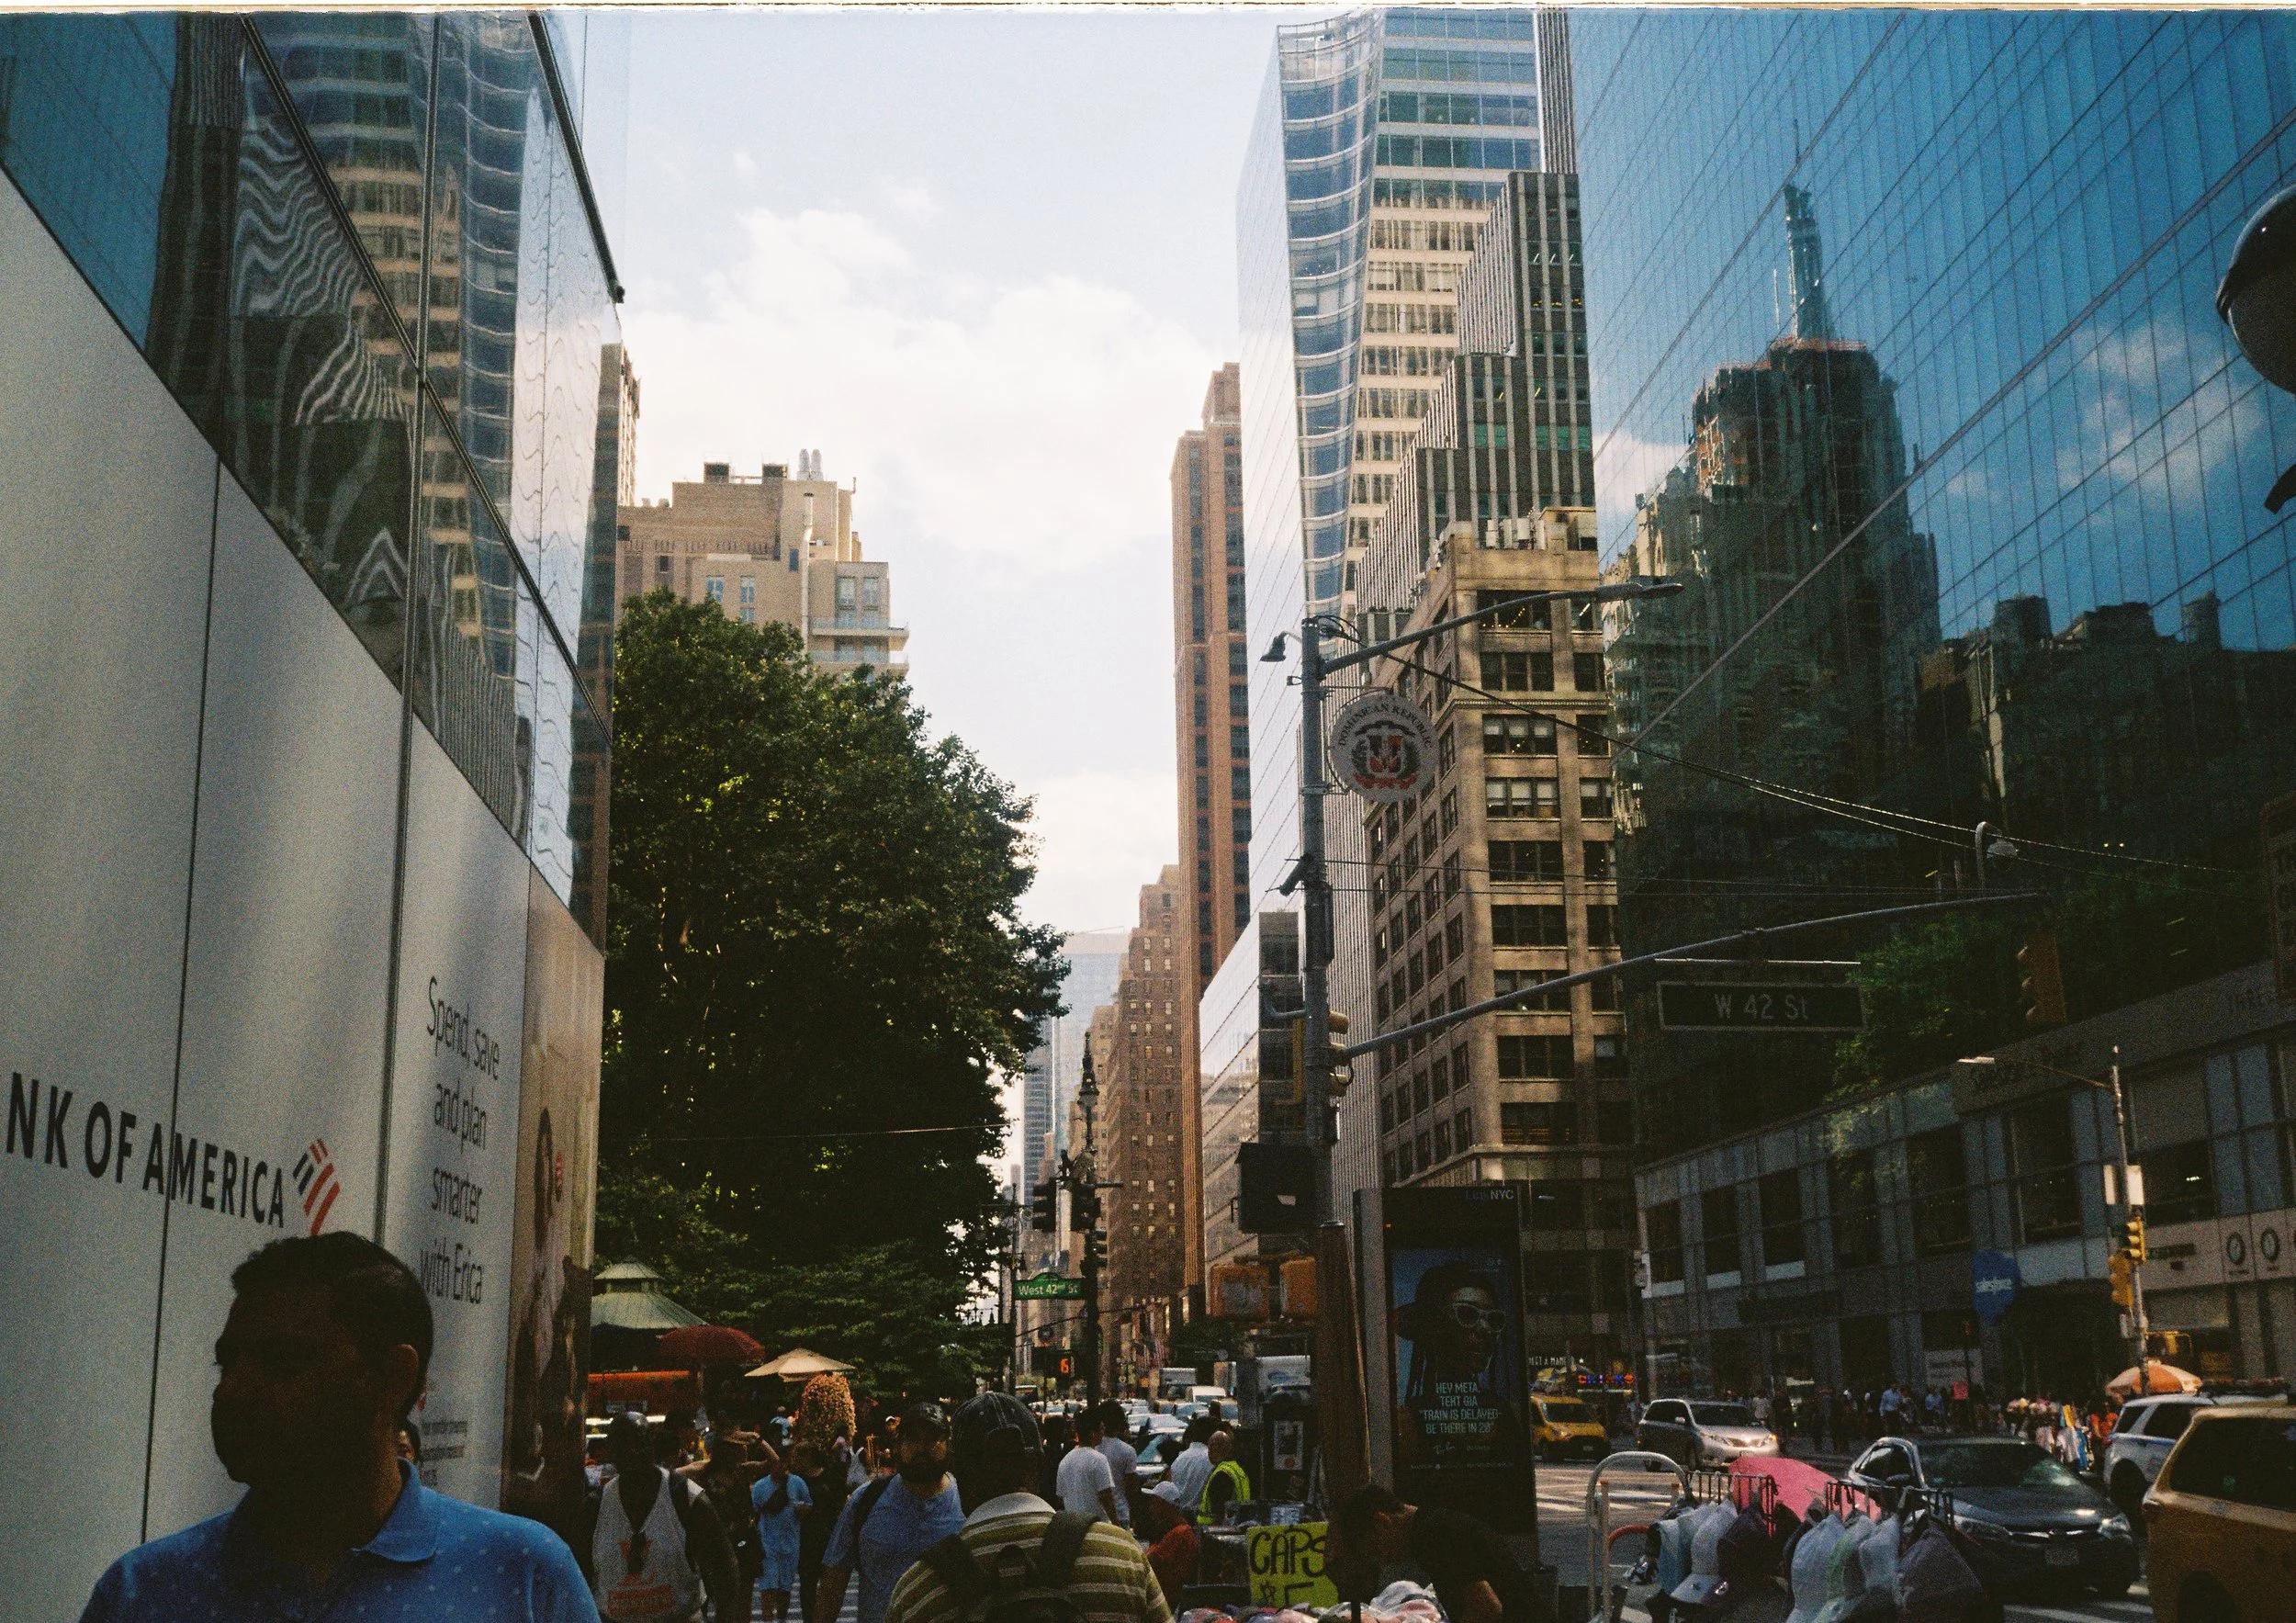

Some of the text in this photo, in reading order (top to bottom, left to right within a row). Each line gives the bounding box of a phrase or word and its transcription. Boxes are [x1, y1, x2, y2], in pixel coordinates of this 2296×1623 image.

[1338, 703, 1433, 748] DOMINICAN REPUBLIC
[1714, 994, 1809, 1020] W 42 St
[473, 1027, 501, 1080] save
[433, 1080, 488, 1154] and plan
[84, 1101, 137, 1183] OF
[142, 1122, 285, 1228] AMERICA
[432, 1167, 483, 1224] smarter
[420, 1237, 484, 1304] with Erica
[1018, 1285, 1045, 1296] West
[1068, 1284, 1079, 1295] St
[1060, 1358, 1070, 1375] 6
[1435, 1382, 1454, 1394] HEY
[1425, 1423, 1437, 1435] BE
[1439, 1422, 1467, 1435] THERE
[1468, 1422, 1478, 1434] IN
[1449, 1409, 1459, 1421] IS
[1250, 1525, 1327, 1577] CAPS
